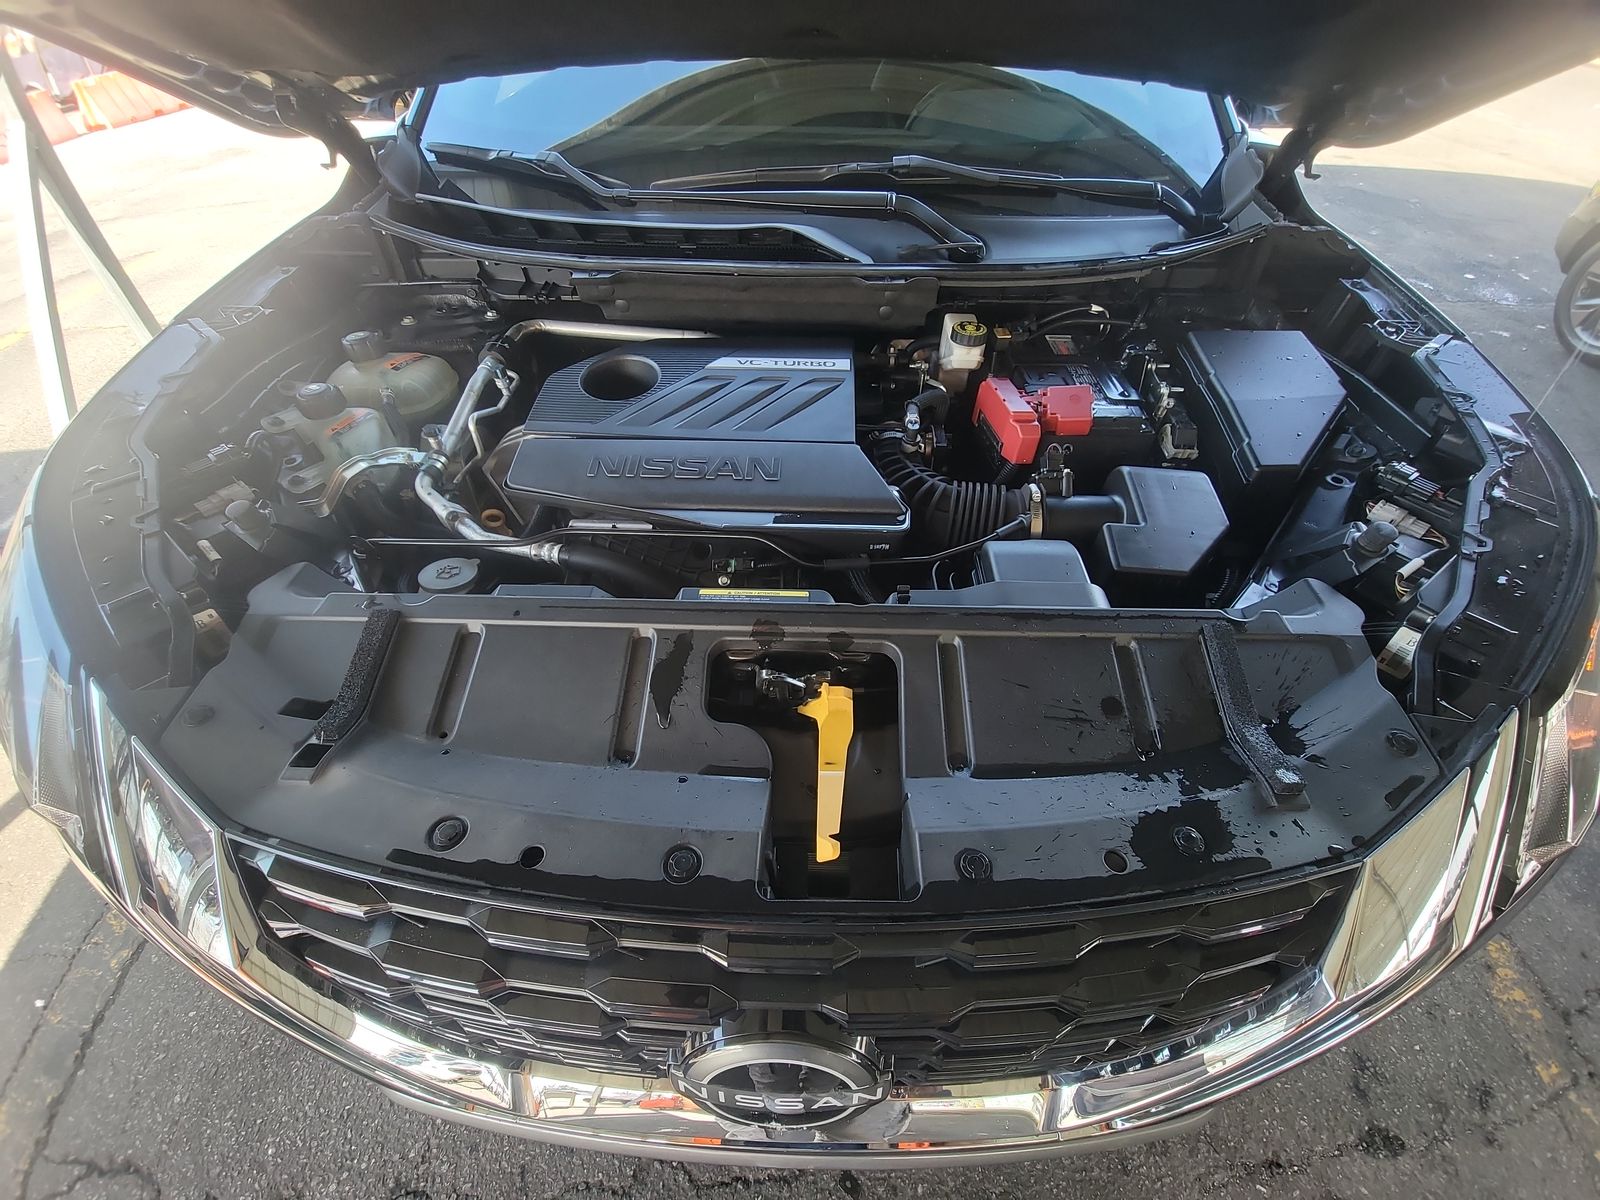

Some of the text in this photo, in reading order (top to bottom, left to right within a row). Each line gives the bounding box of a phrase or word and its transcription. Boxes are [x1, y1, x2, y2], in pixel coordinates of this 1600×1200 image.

[735, 358, 837, 368] VC-TURBO
[586, 455, 783, 481] NISSAN
[677, 1079, 884, 1110] NISSAN
